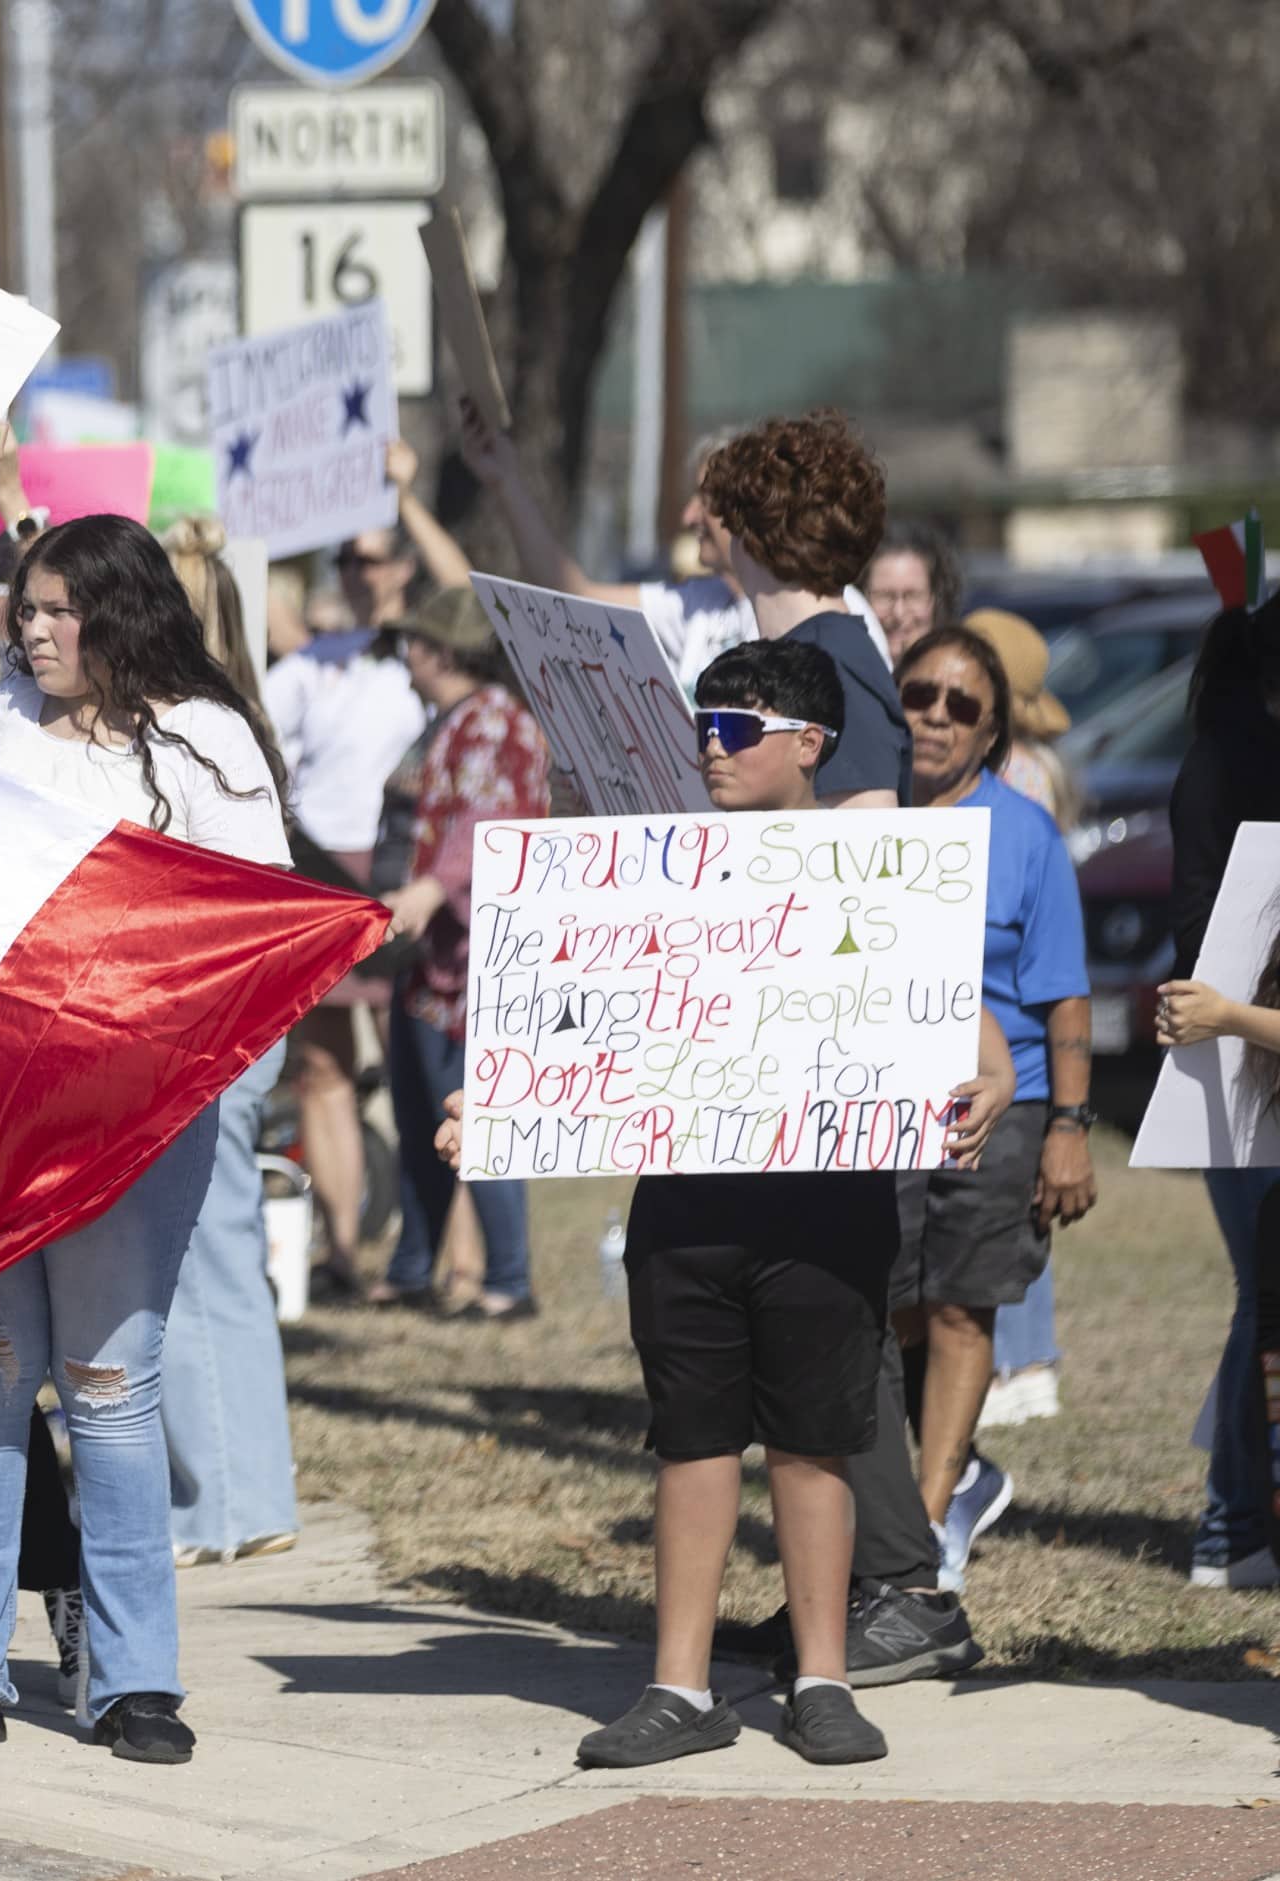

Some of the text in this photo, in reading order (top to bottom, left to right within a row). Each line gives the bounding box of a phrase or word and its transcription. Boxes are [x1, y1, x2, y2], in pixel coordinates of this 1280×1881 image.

[253, 111, 428, 166] NORTH
[300, 228, 377, 307] 16
[746, 821, 974, 904] Saving
[476, 892, 899, 979] The immigrant is
[472, 971, 641, 1055] Helping
[641, 969, 732, 1043] the
[751, 965, 893, 1052] people
[636, 1040, 781, 1101] Lose
[804, 1037, 896, 1099] for
[466, 1089, 956, 1177] IMMIGRATION REFORM
